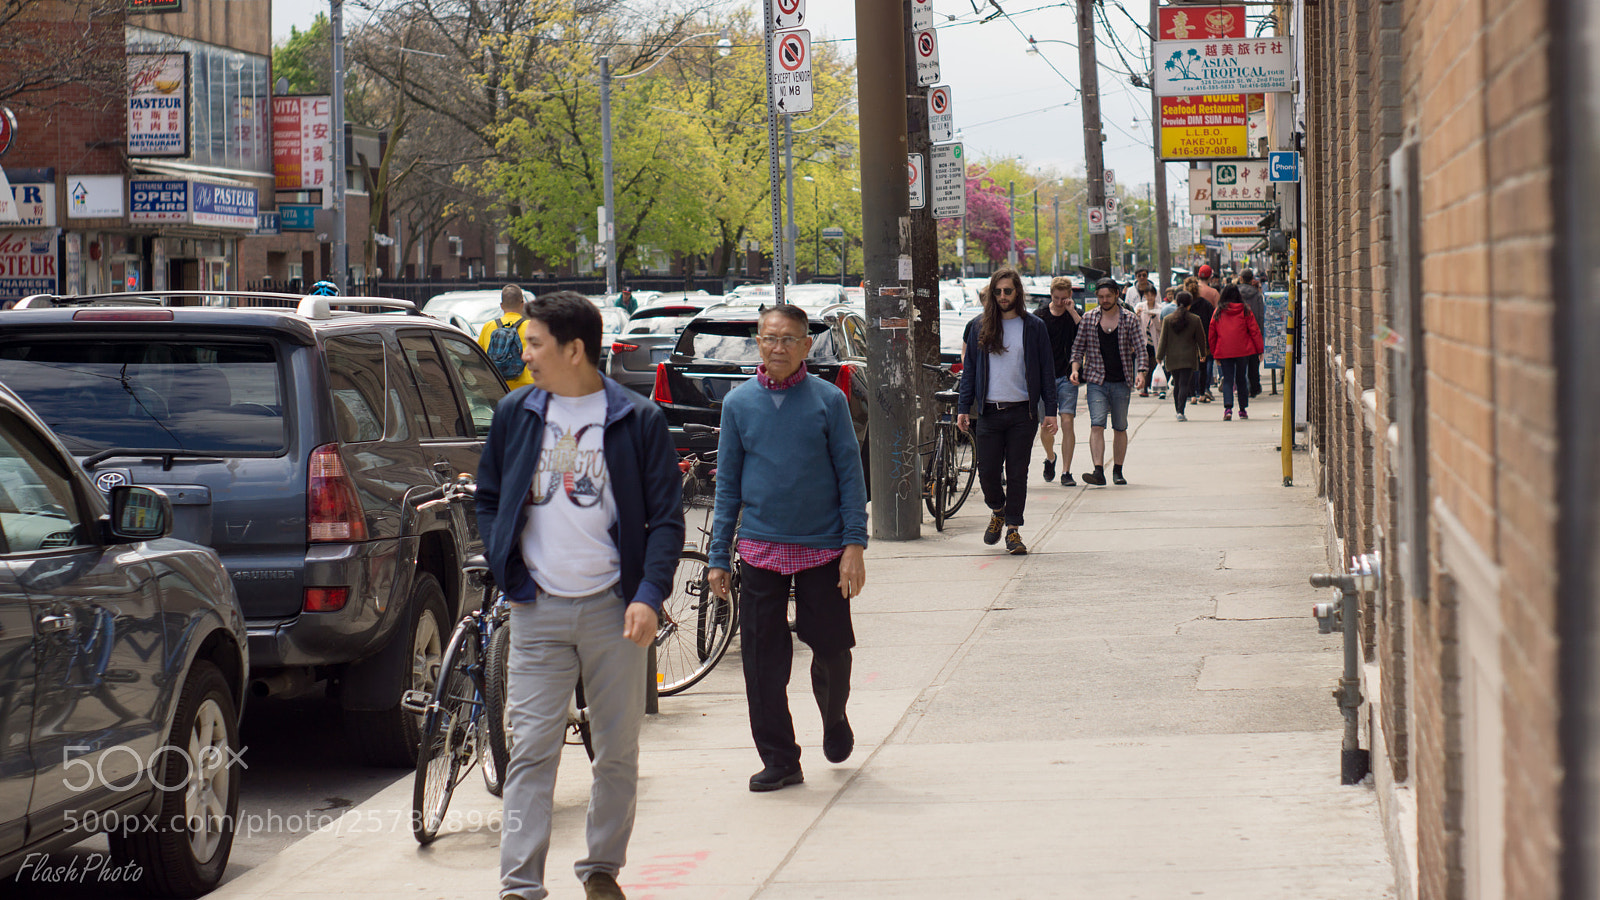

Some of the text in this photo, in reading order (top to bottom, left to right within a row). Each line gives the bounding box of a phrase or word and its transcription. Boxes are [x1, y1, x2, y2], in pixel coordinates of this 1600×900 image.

[1204, 41, 1283, 56] 越美旅行社
[1201, 57, 1238, 68] ASIAN
[774, 70, 810, 85] EXCEPT VENDOR
[1201, 66, 1266, 79] TROPICAL
[789, 85, 800, 96] M8
[130, 97, 181, 109] PASTEUR
[274, 100, 300, 114] VITA
[1163, 103, 1245, 115] Seafood Restaurant
[1162, 115, 1245, 126] Provide DIM SUM All Day
[1186, 128, 1223, 136] L.L.B.O.
[1180, 138, 1229, 146] TAKE-OUT
[1171, 146, 1238, 155] 416-597-0888
[134, 191, 185, 202] OPEN
[214, 188, 254, 207] PASTEUR
[134, 203, 185, 211] 24 HRS
[282, 209, 298, 218] VITA
[232, 570, 295, 580] 4RUNNER
